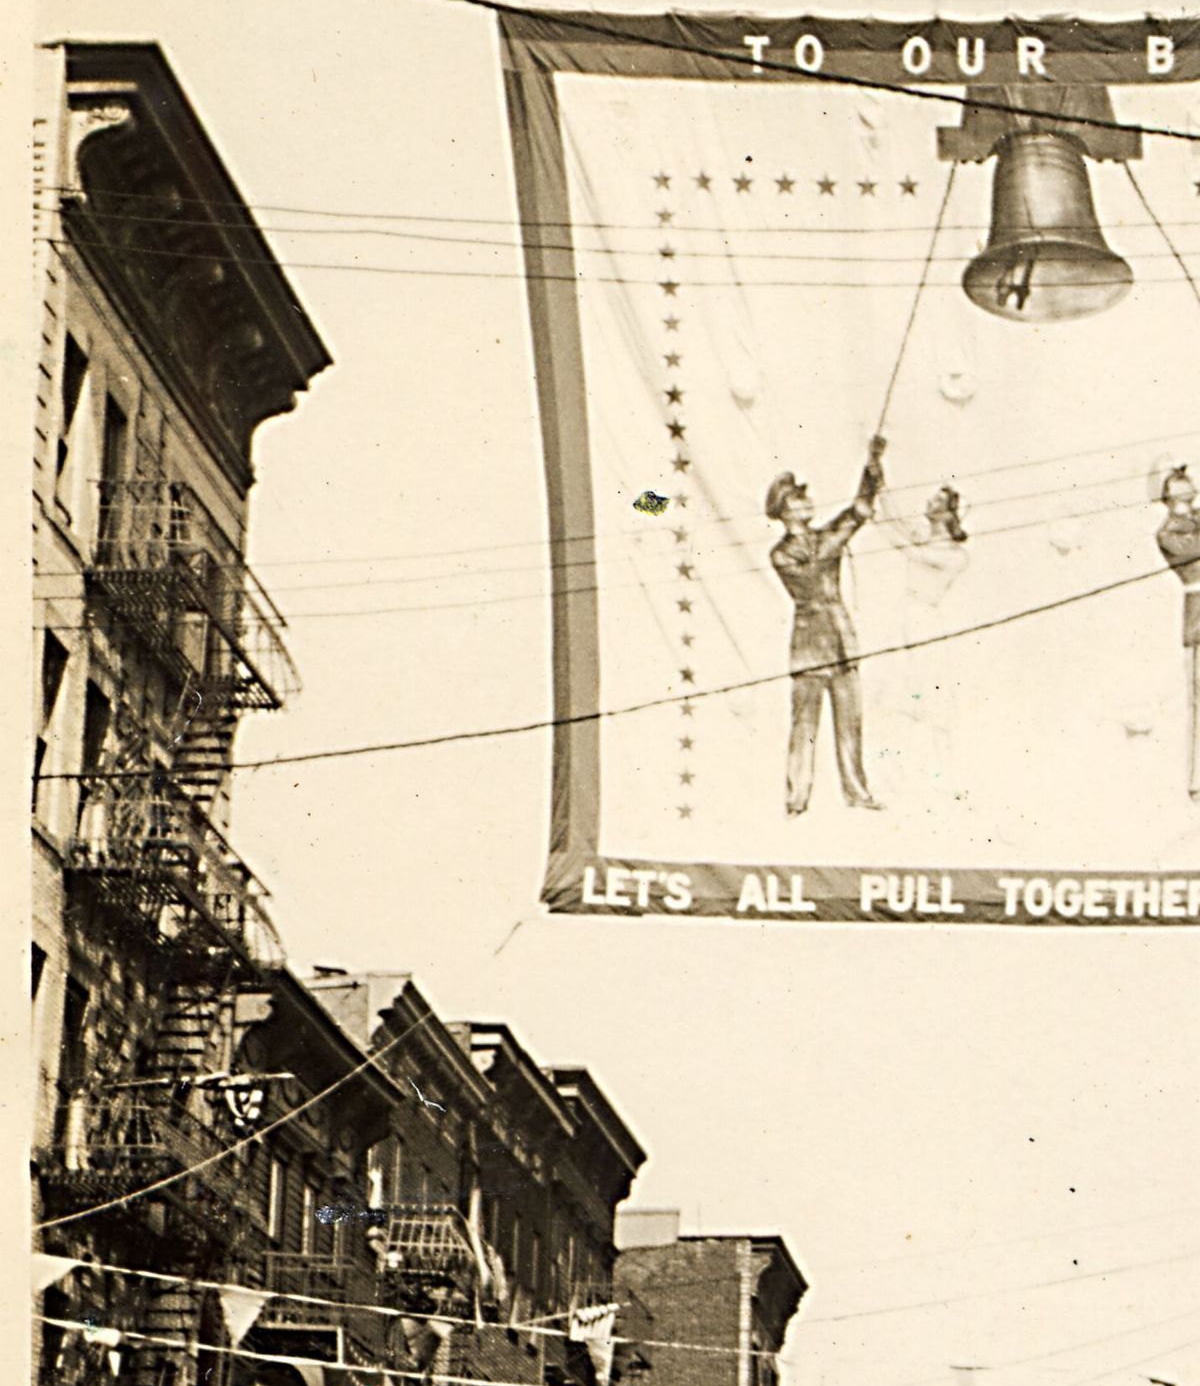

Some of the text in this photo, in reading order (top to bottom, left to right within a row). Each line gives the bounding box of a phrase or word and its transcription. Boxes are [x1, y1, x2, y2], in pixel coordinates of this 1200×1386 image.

[743, 34, 824, 74] TO
[901, 36, 1047, 75] OUR
[583, 866, 692, 908] LET'S
[736, 874, 816, 912] ALL
[859, 874, 964, 914] PULL
